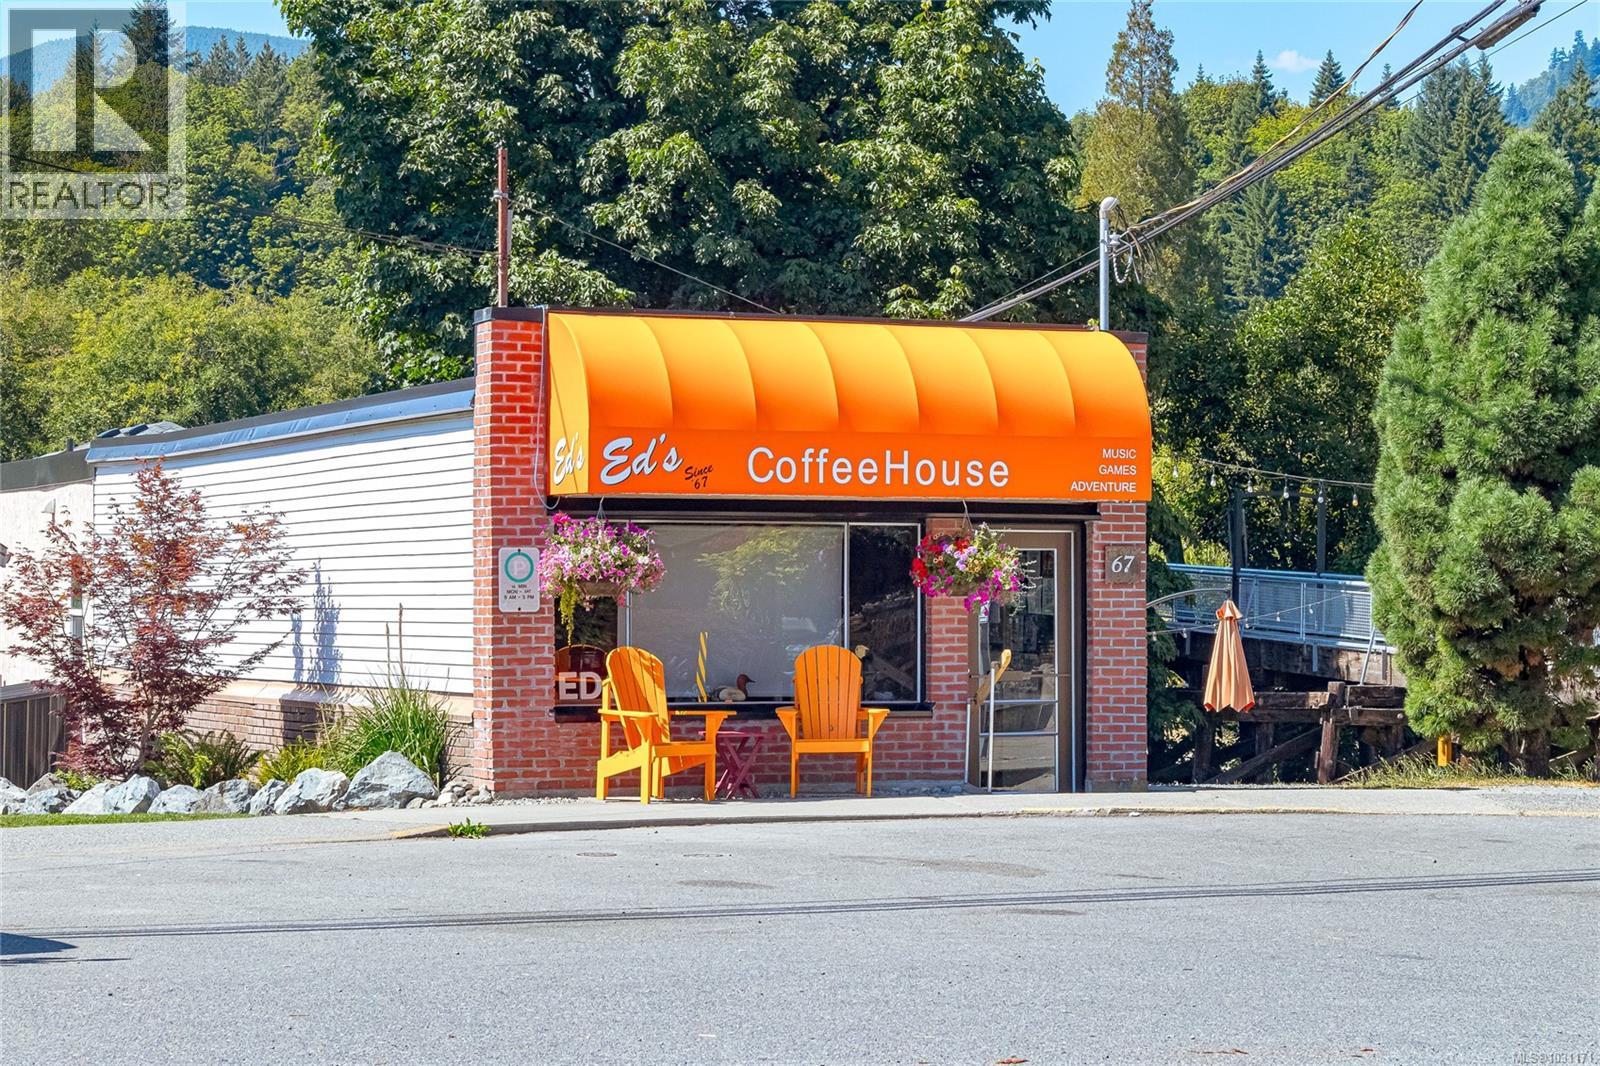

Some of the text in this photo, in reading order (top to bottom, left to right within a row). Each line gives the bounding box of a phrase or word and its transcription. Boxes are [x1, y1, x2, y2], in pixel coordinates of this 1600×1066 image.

[553, 432, 584, 485] Ed's
[600, 433, 683, 485] Ed's
[1102, 448, 1137, 459] MUSIC
[684, 464, 714, 481] Since
[747, 446, 1010, 488] CoffeeHouse
[1098, 464, 1137, 475] GAMES
[1070, 481, 1137, 493] ADVENTURE
[1111, 555, 1135, 573] 67
